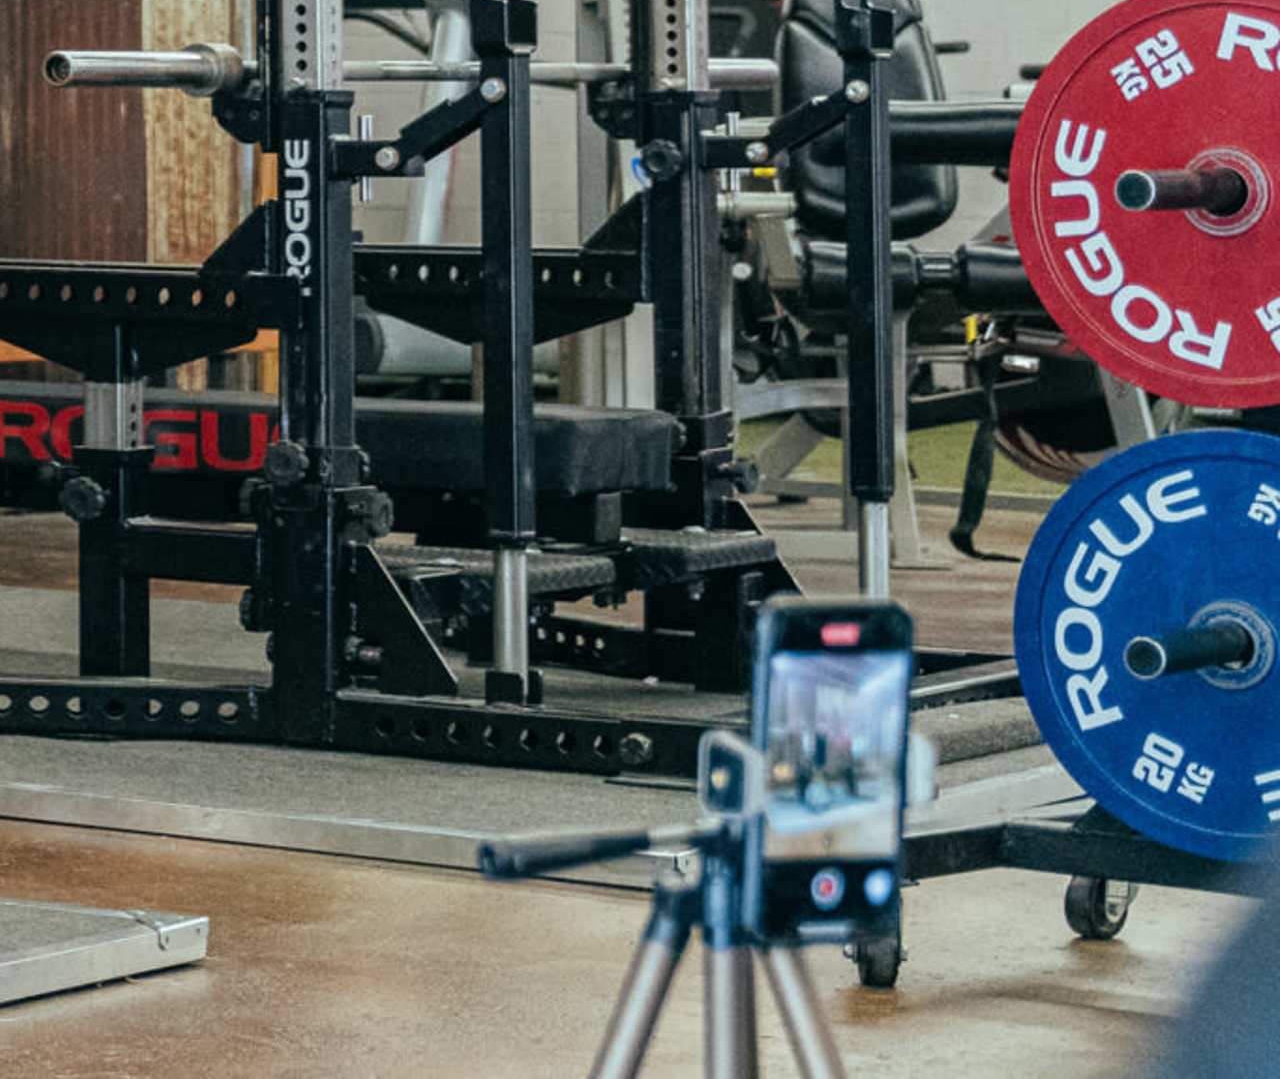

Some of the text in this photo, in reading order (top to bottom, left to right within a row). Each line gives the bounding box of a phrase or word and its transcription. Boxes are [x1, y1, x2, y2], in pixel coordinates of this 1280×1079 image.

[1110, 58, 1149, 102] KG
[1135, 29, 1194, 90] 25
[1050, 119, 1232, 370] ROGUE
[1054, 469, 1207, 732] ROGUE
[1131, 731, 1185, 794] 20
[1176, 761, 1216, 804] KG
